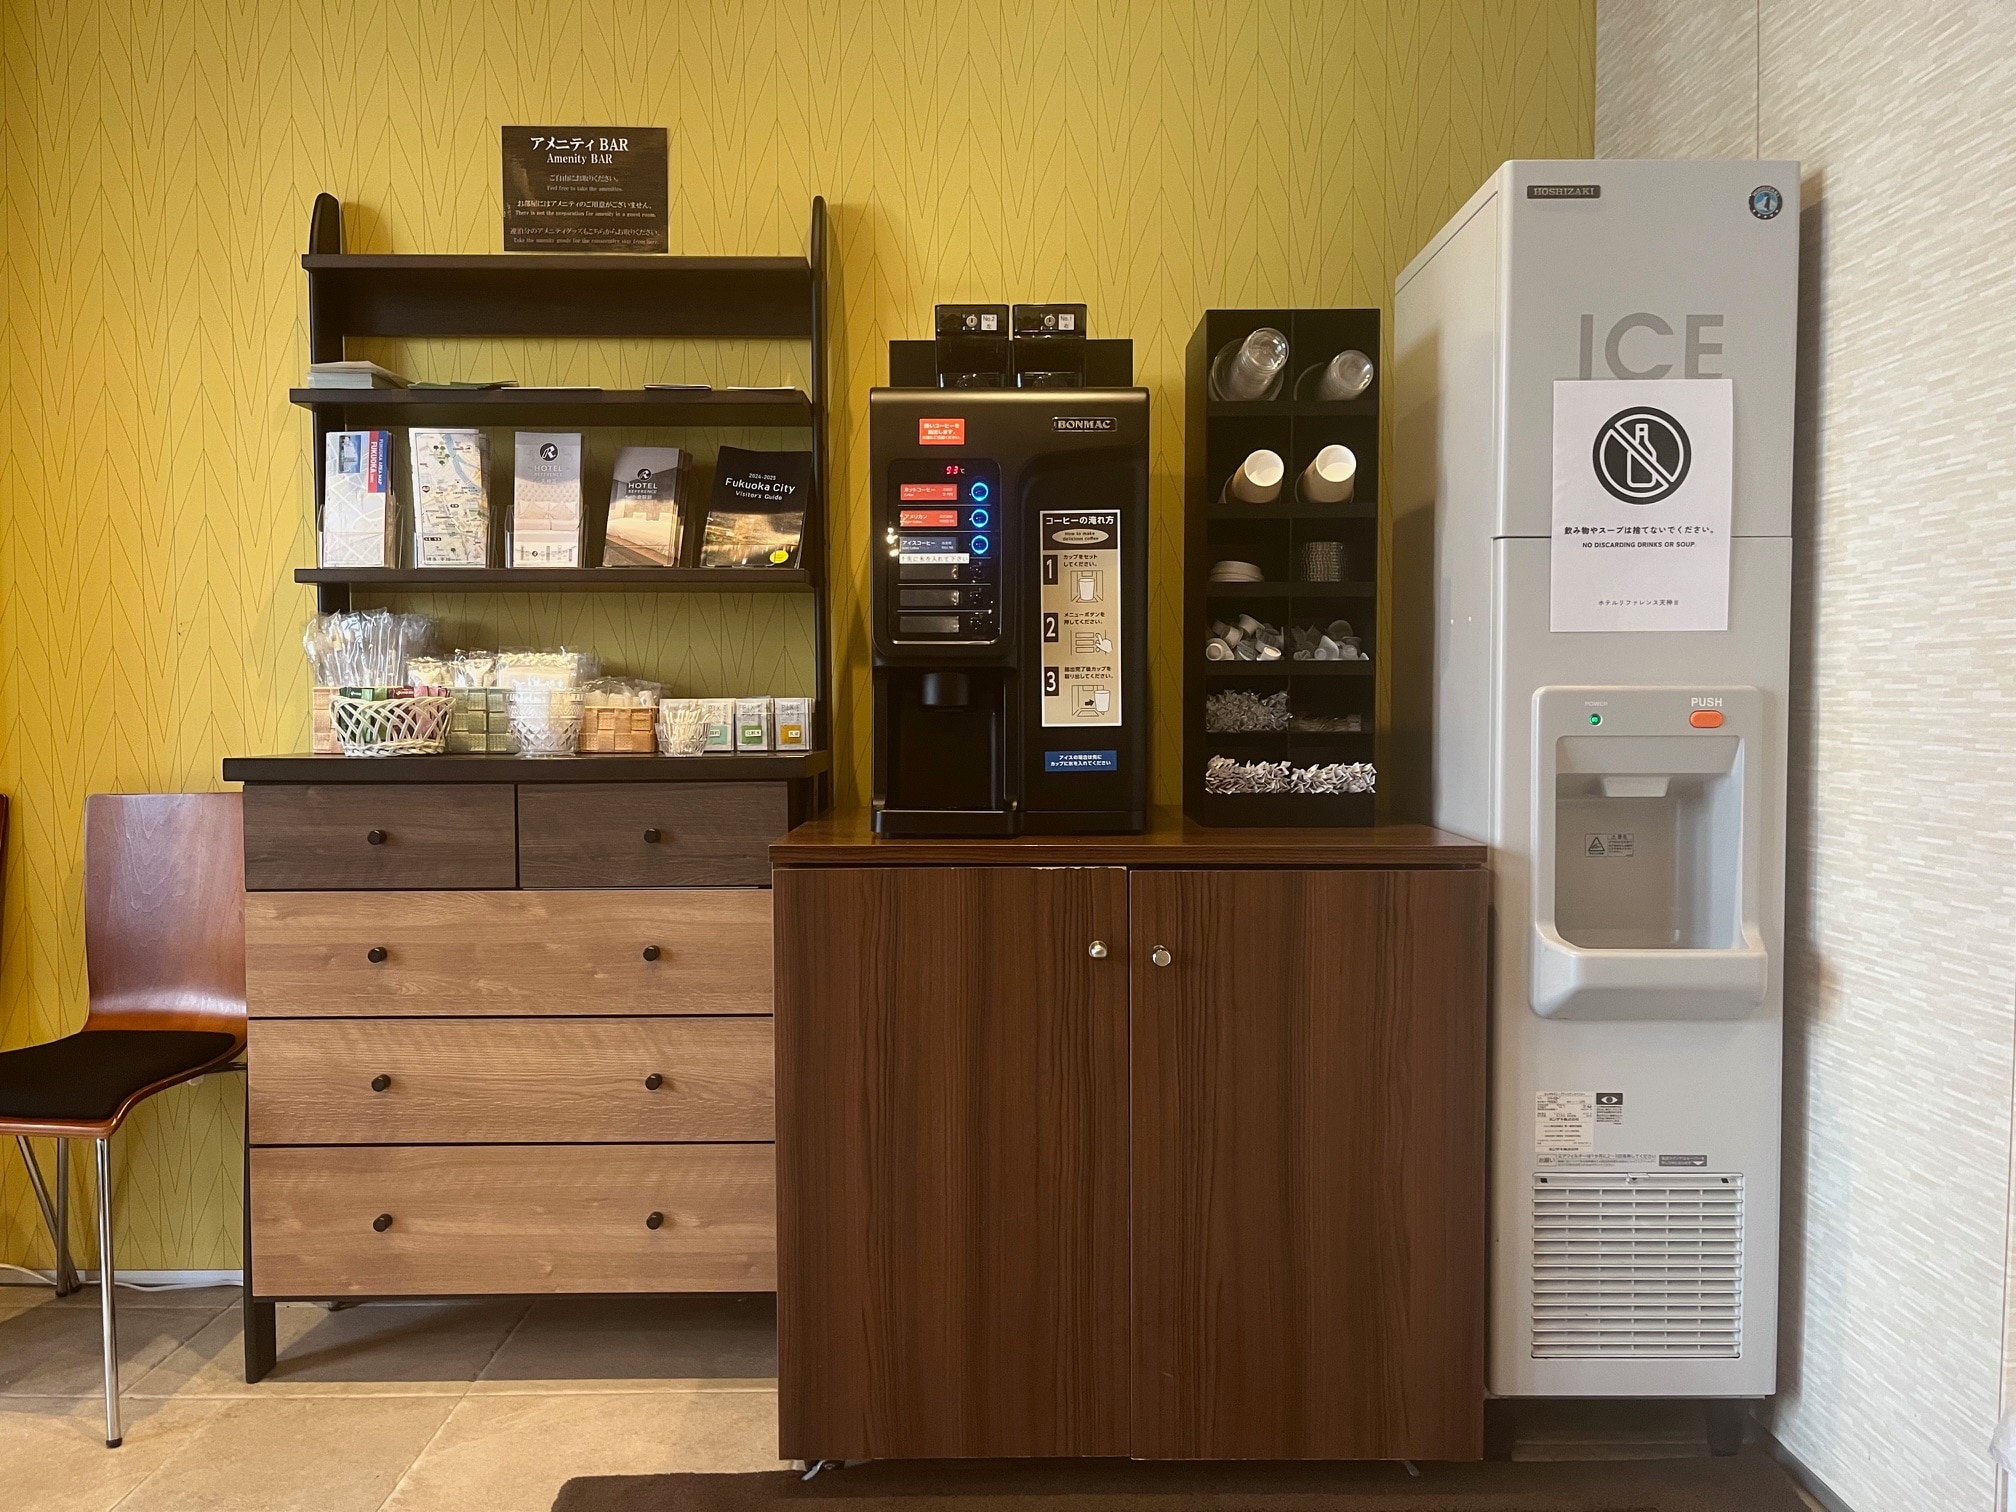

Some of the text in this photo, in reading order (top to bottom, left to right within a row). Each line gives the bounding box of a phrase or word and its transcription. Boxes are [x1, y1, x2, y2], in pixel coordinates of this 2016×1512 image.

[530, 136, 629, 151] アメニティ BAR
[546, 153, 613, 165] Amenity BAR
[1533, 187, 1595, 196] HOSHIZAKI
[1579, 312, 1724, 380] ICE
[1057, 420, 1111, 429] BONMAC
[370, 441, 378, 473] FUKUOKA
[946, 465, 959, 475] 93
[748, 472, 777, 481] 2024-2025
[725, 477, 796, 495] Fukuoka City
[735, 490, 783, 501] Visitor's Guide
[1045, 515, 1115, 525] コーヒーの淹れ方
[1564, 525, 1714, 535] 飲み物やスープは捨てないでください。
[1046, 558, 1052, 579] 1
[1046, 617, 1056, 638] 2
[1046, 671, 1057, 692] 3
[1690, 697, 1723, 707] PUSH
